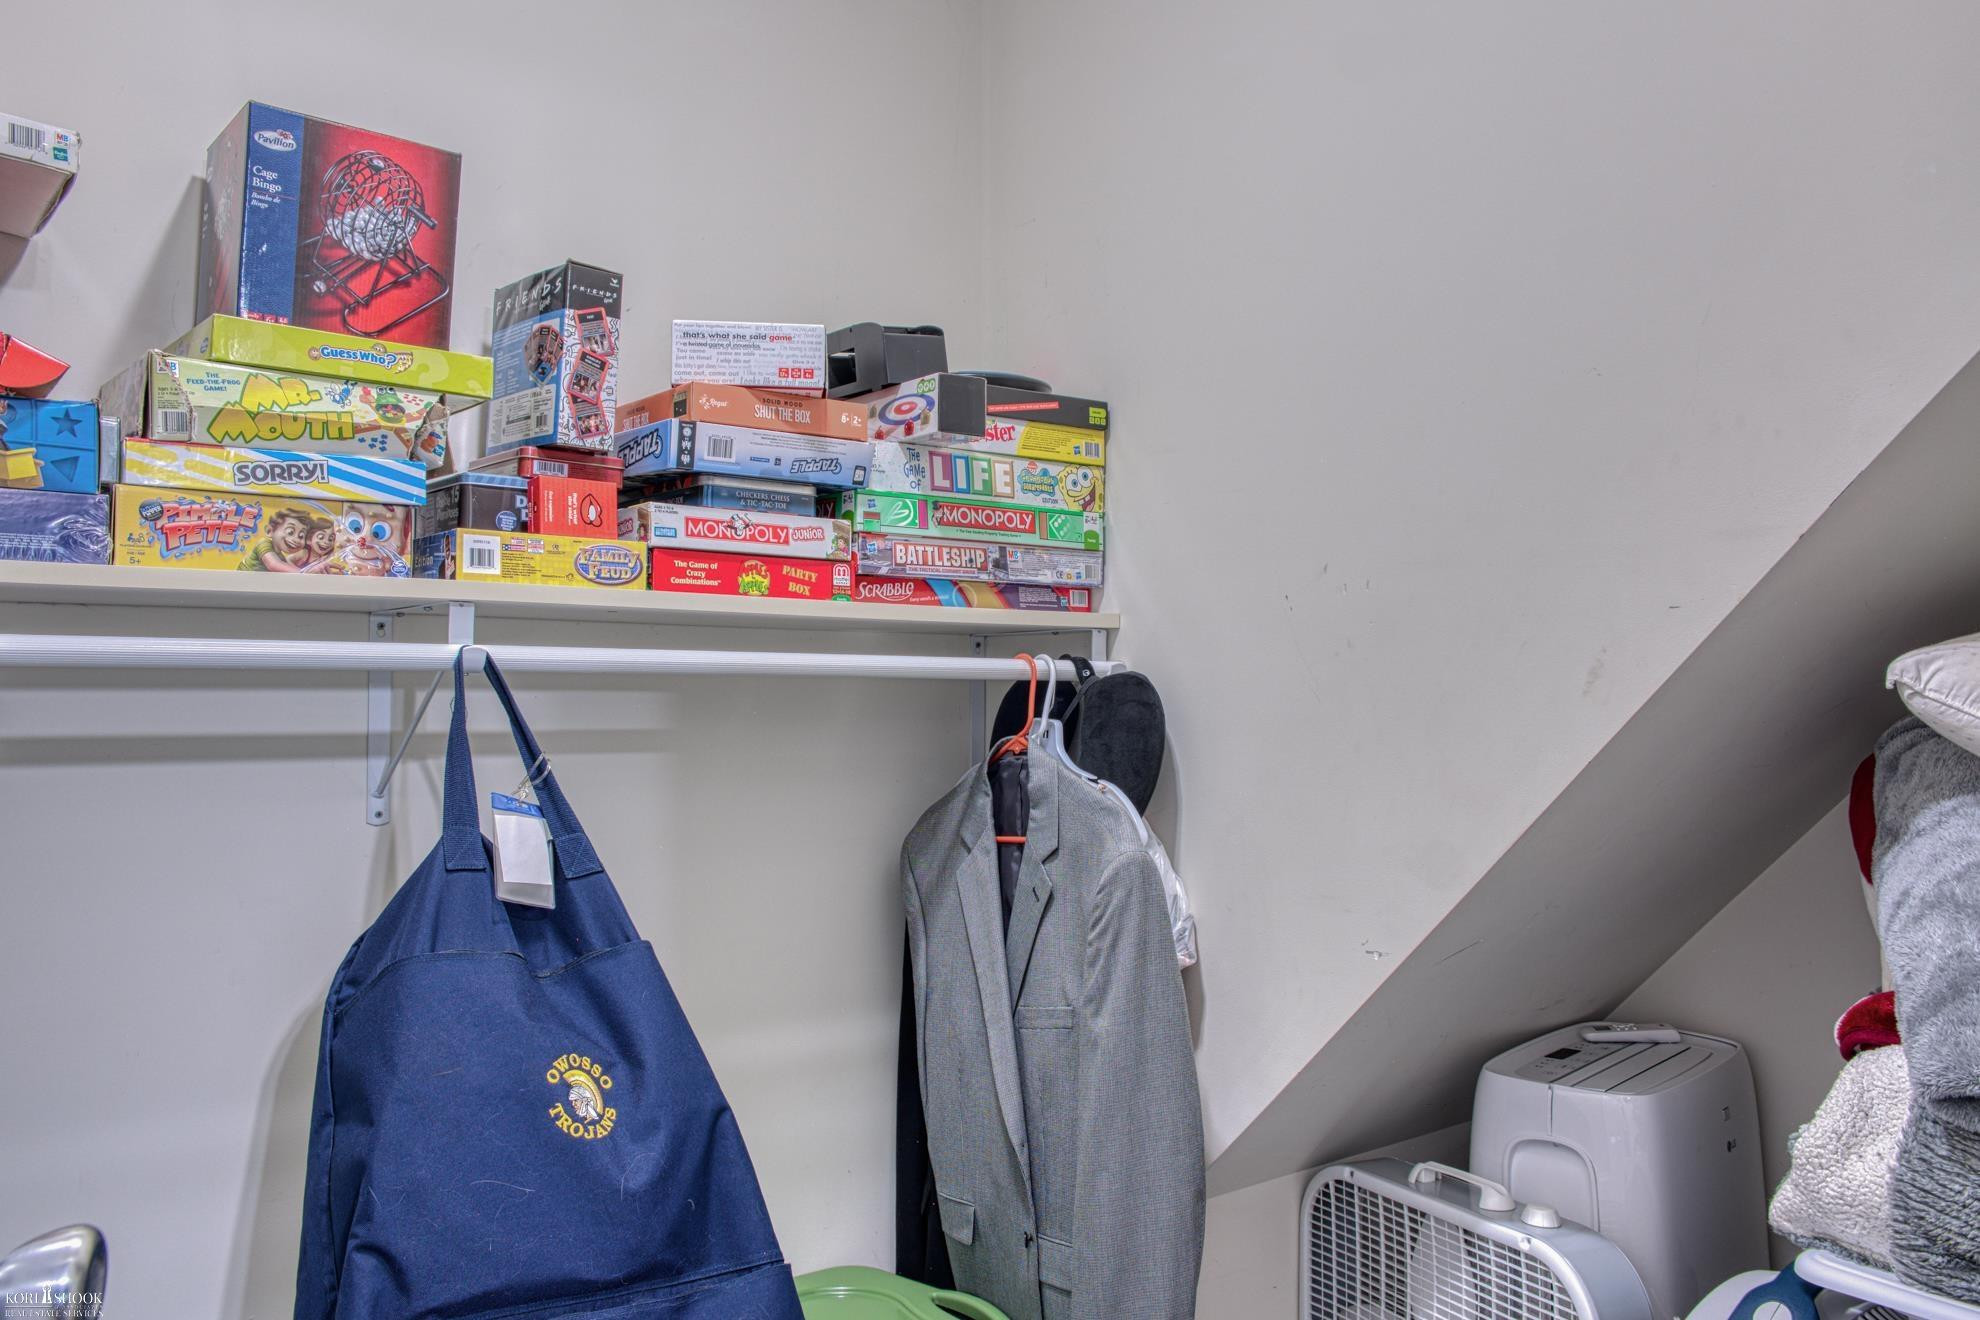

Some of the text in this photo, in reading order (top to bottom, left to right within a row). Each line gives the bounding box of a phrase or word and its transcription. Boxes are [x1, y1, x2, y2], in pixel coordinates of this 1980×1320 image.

[258, 133, 294, 149] Pavilion
[252, 165, 278, 180] Cage
[252, 177, 282, 193] Bingo
[682, 331, 706, 339] that's
[708, 332, 730, 340] what
[732, 332, 747, 340] she
[749, 333, 767, 341] said
[768, 335, 793, 343] game
[762, 398, 781, 406] SOLID
[206, 400, 355, 444] MOUTH
[754, 404, 811, 425] SHUT THE BOX
[984, 423, 1016, 442] ster
[234, 461, 328, 485] SORRY!
[790, 457, 842, 475] TAPPLE
[929, 451, 1015, 498] LIFE
[770, 494, 791, 502] CHESS
[943, 505, 1033, 530] MONOPOLY
[162, 520, 240, 552] PETE
[686, 520, 788, 544] MONOPOLY
[129, 556, 142, 564] 5+
[578, 547, 641, 568] FAMILY
[673, 560, 718, 570] The Game of
[895, 543, 986, 569] BATTLESHIP
[587, 561, 632, 580] FEUD
[686, 569, 706, 579] Crazy
[782, 564, 818, 583] PARTY
[788, 581, 811, 597] BOX
[855, 581, 914, 601] SCRABBLE
[546, 1053, 613, 1089] OWOSSO
[549, 1102, 617, 1139] TROJANS
